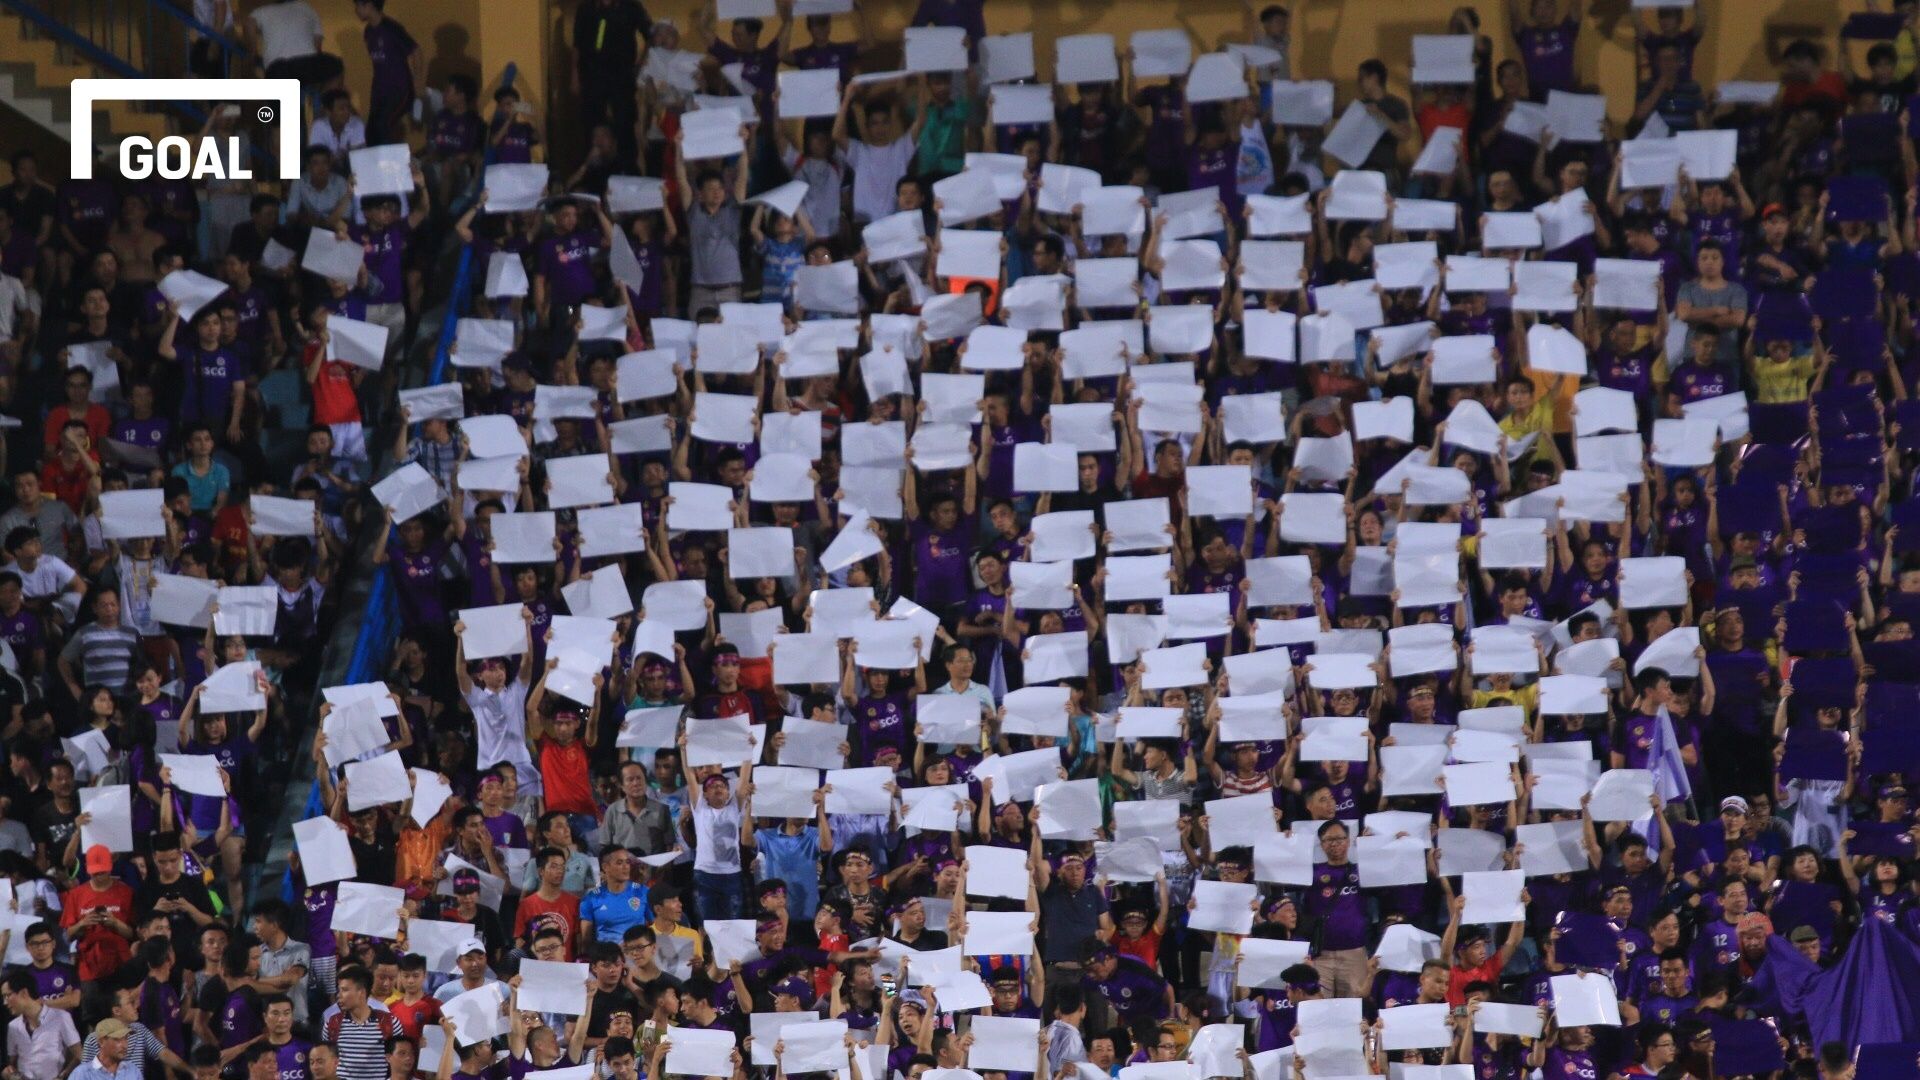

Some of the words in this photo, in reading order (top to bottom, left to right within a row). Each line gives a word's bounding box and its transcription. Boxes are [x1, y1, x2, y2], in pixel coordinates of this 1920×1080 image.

[203, 366, 226, 378] SCG
[1701, 384, 1721, 396] SCG
[125, 428, 136, 441] 12
[1062, 607, 1081, 618] SCG
[879, 714, 898, 728] SCG
[1335, 799, 1353, 811] SCG
[1713, 934, 1727, 947] 12
[1645, 965, 1659, 977] 12
[1535, 983, 1548, 993] 12
[282, 1069, 303, 1080] SCG
